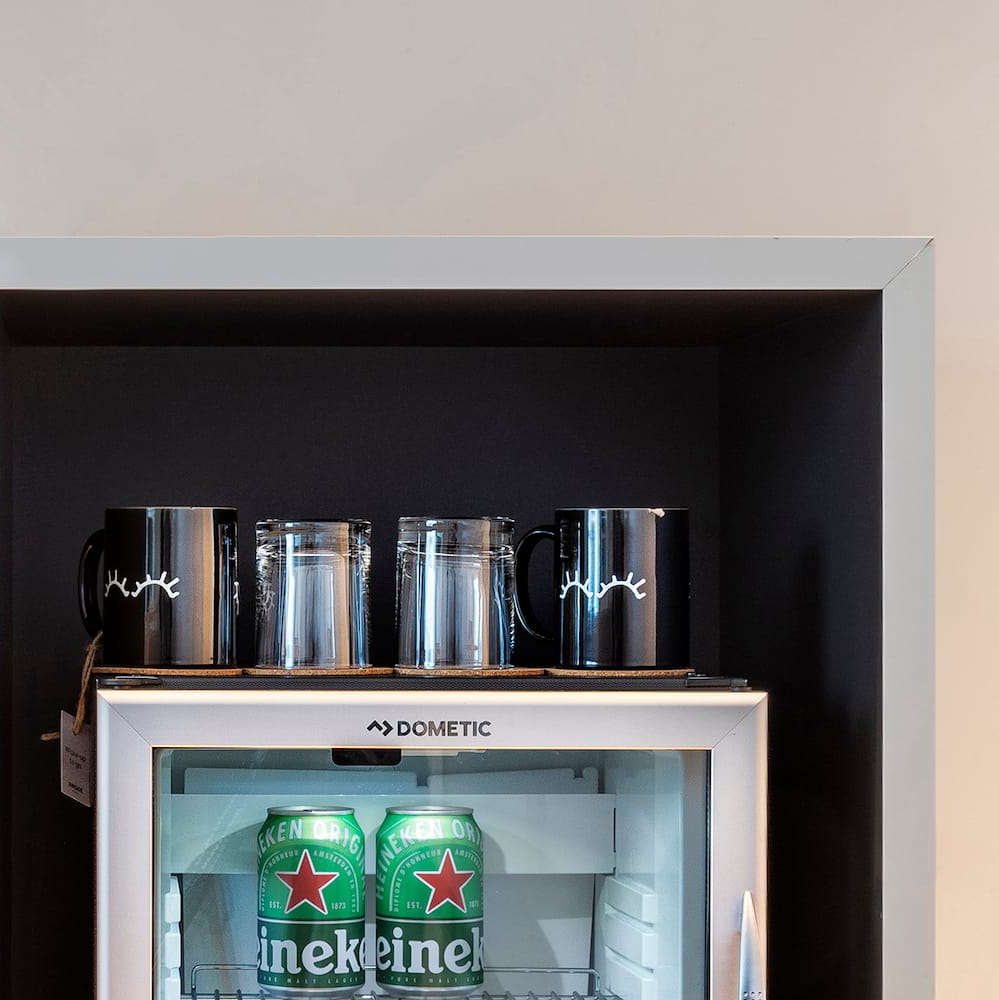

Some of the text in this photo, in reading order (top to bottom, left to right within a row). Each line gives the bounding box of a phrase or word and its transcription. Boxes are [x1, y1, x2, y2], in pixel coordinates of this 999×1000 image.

[397, 720, 492, 737] DOMETIC
[376, 821, 444, 900] HEINEKEN
[269, 901, 346, 910] EST. 1873
[406, 901, 422, 909] EST.
[257, 926, 365, 976] inek
